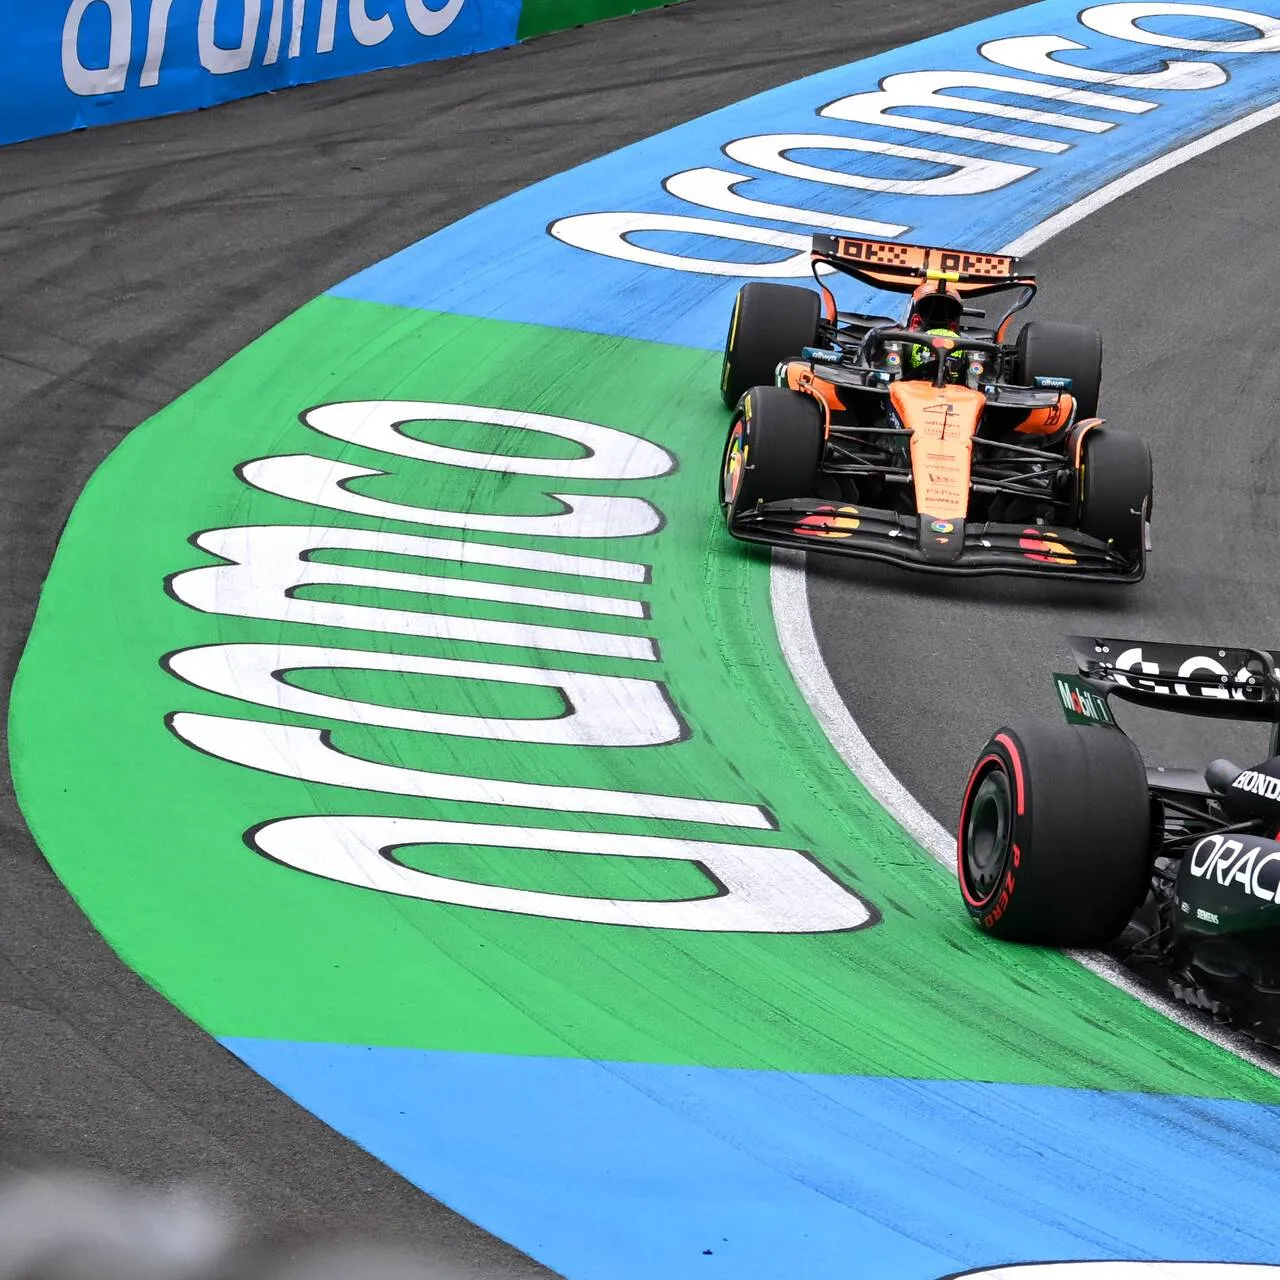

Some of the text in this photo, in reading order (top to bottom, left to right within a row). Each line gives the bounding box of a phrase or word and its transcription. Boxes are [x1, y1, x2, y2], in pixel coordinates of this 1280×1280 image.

[812, 351, 838, 361] allwyn
[1041, 378, 1065, 387] allwyn
[159, 399, 882, 934] aramco
[1057, 679, 1099, 719] Mobil
[984, 843, 1021, 928] P ZERO
